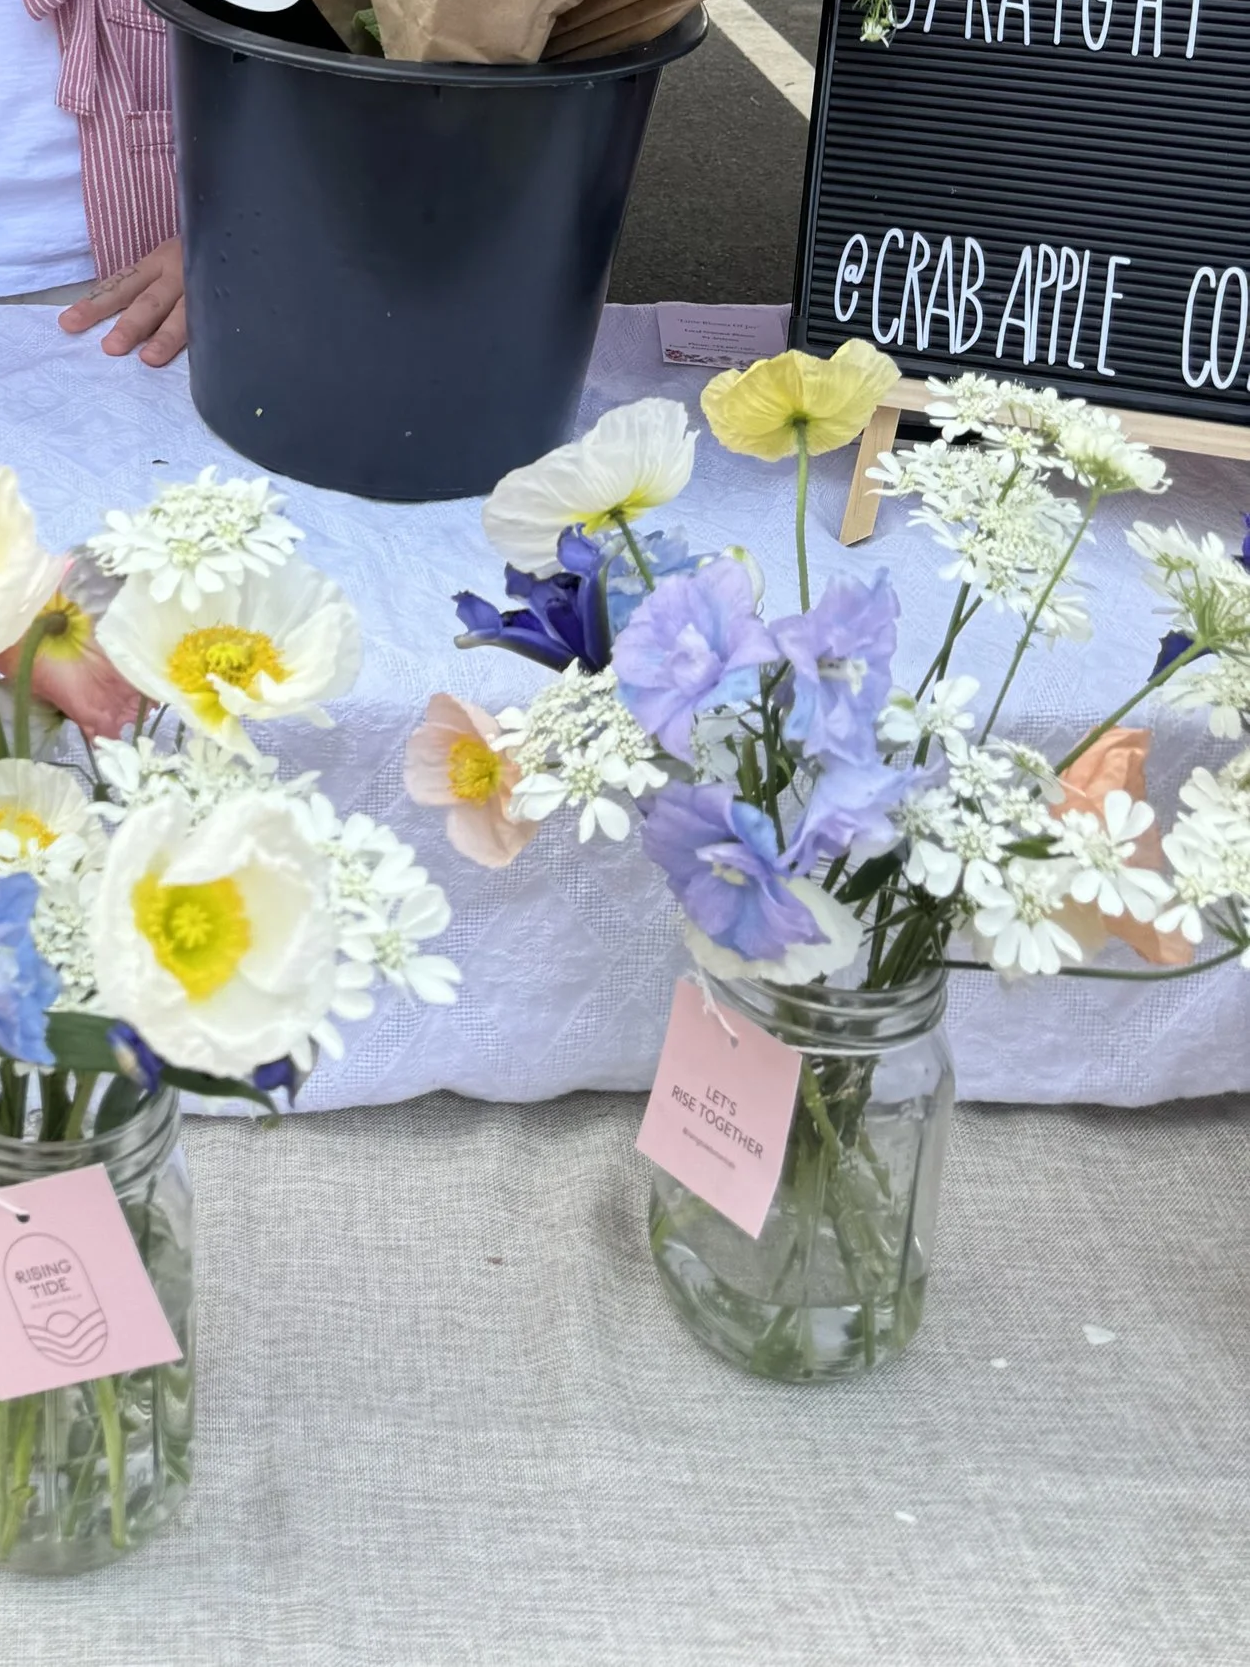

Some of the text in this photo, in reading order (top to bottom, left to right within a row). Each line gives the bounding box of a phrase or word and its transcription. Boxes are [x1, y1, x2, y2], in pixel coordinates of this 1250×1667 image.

[1181, 266, 1250, 390] CO
[705, 1084, 738, 1117] LET'S
[670, 1084, 696, 1113] RISE
[699, 1103, 764, 1160] TOGETHER
[14, 1258, 73, 1285] RISING
[28, 1276, 71, 1299] TIDE
